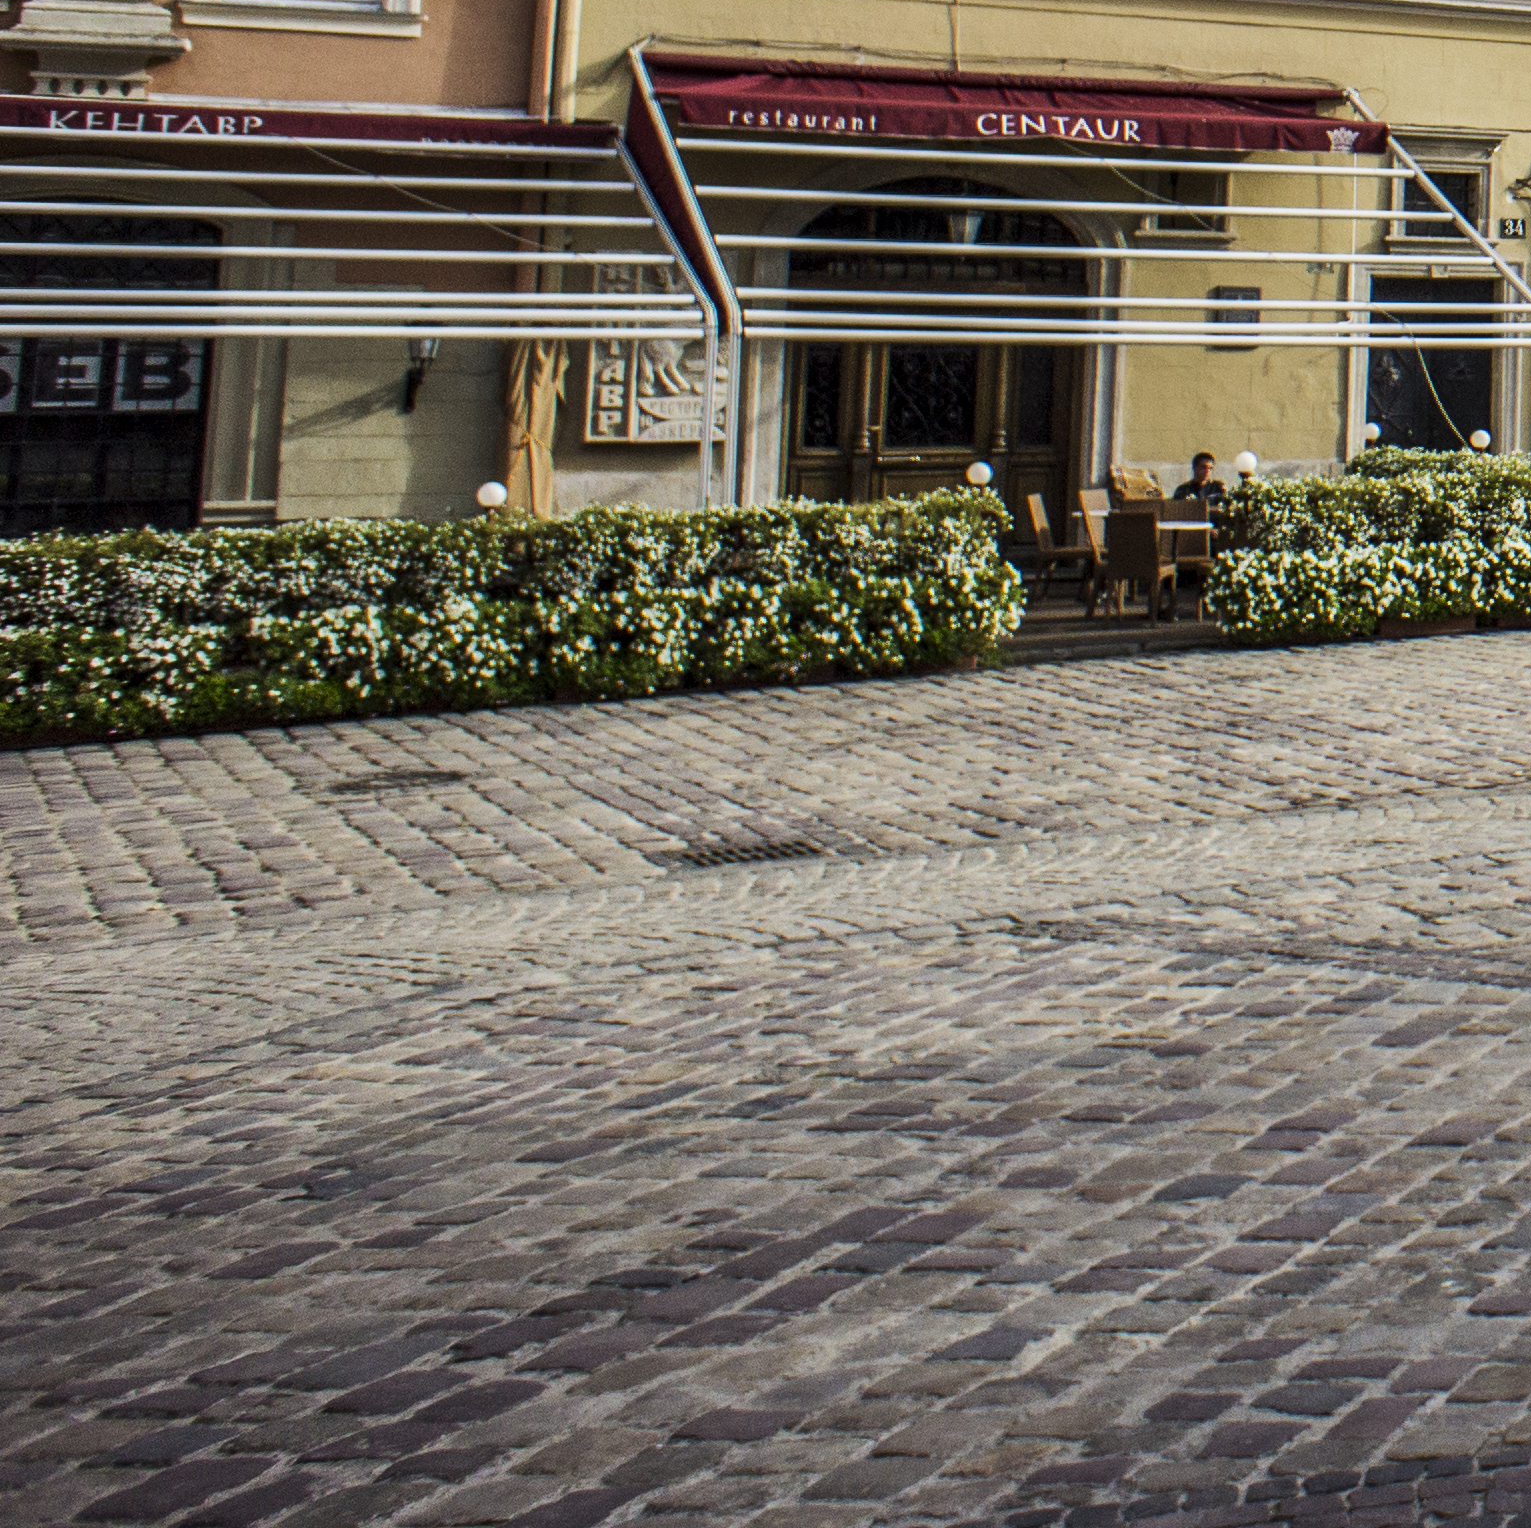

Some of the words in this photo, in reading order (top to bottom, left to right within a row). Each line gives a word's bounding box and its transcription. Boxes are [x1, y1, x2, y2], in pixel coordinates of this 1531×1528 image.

[50, 110, 263, 134] КЕНТАВР
[728, 107, 877, 132] restaurant
[976, 112, 1141, 143] CENTAUR
[1503, 218, 1524, 236] 34
